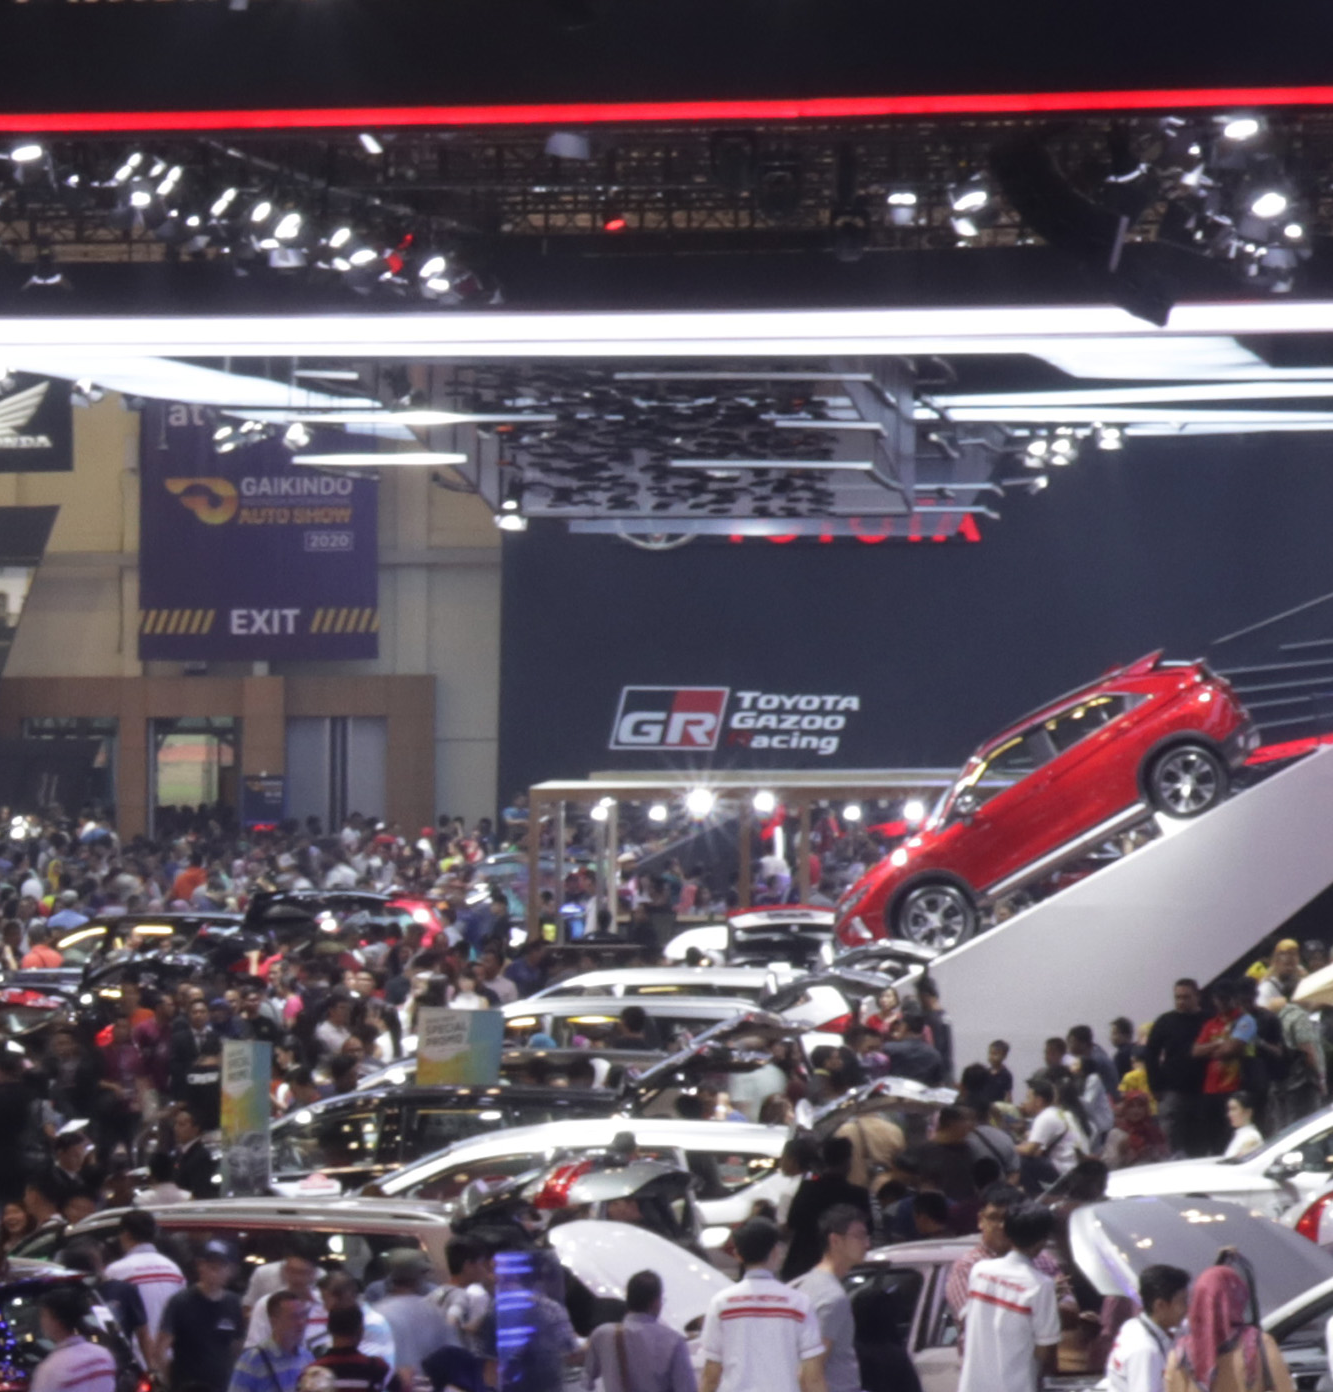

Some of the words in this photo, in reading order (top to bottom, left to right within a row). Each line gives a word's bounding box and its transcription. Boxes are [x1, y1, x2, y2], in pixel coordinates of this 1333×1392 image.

[241, 477, 353, 496] GAIKINDO
[239, 508, 290, 525] AUTO
[295, 507, 352, 525] SHOW
[309, 534, 349, 548] 2020
[230, 608, 301, 635] EXIT
[736, 690, 860, 711] TOYOTA
[617, 711, 717, 745] GR
[730, 711, 846, 731] GAZOO
